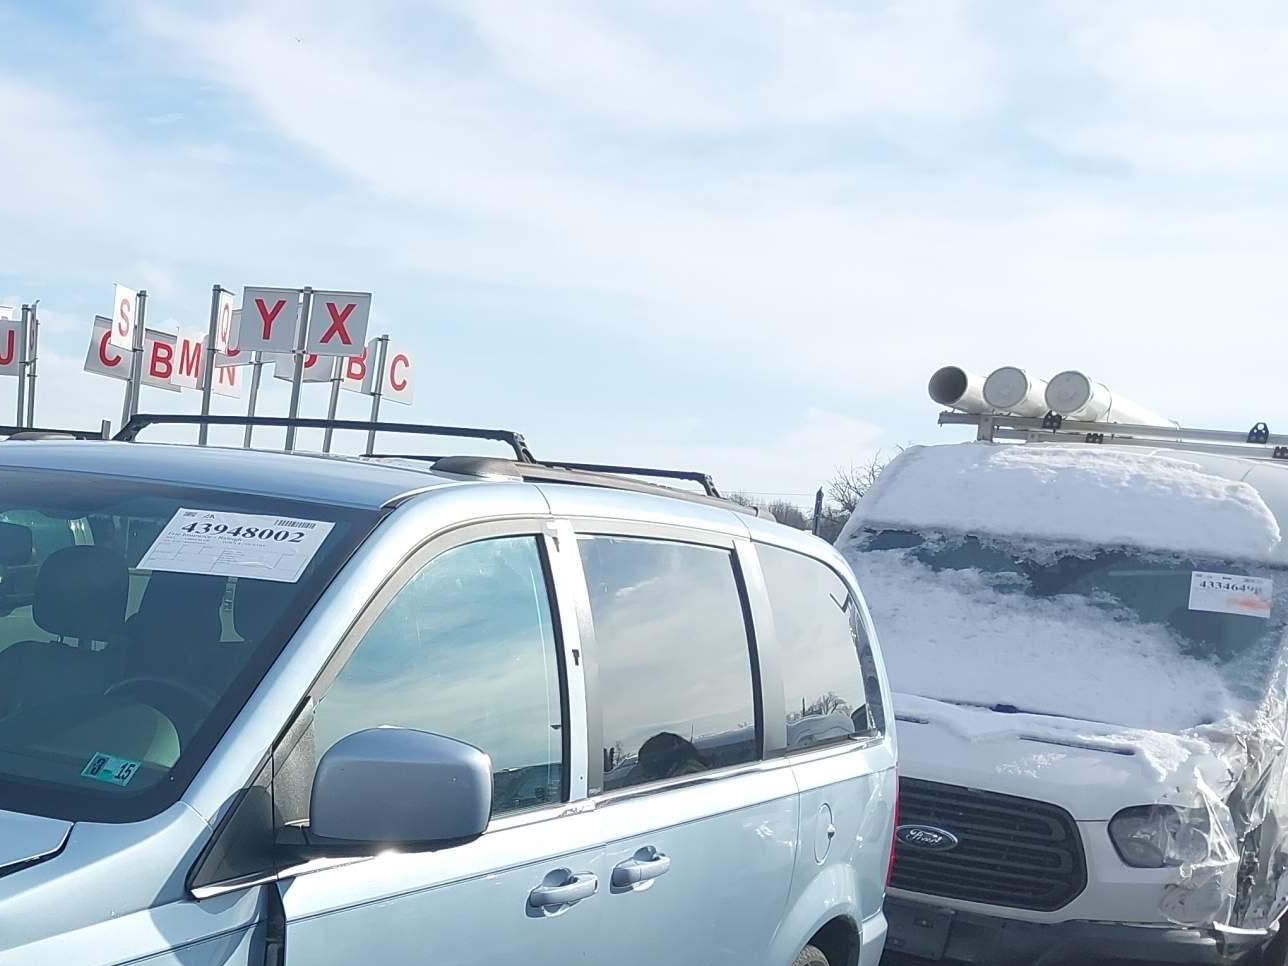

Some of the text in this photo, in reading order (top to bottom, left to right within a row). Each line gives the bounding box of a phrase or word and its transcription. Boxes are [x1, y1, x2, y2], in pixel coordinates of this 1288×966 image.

[118, 298, 131, 337] S
[220, 302, 230, 343] Q
[255, 298, 287, 340] Y
[319, 302, 357, 345] X
[99, 331, 122, 366] C
[149, 341, 173, 379] B
[178, 339, 202, 378] M
[346, 346, 368, 380] B
[390, 354, 410, 391] C
[181, 522, 305, 543] 43948002
[114, 763, 136, 780] 15
[905, 828, 943, 843] Ford
